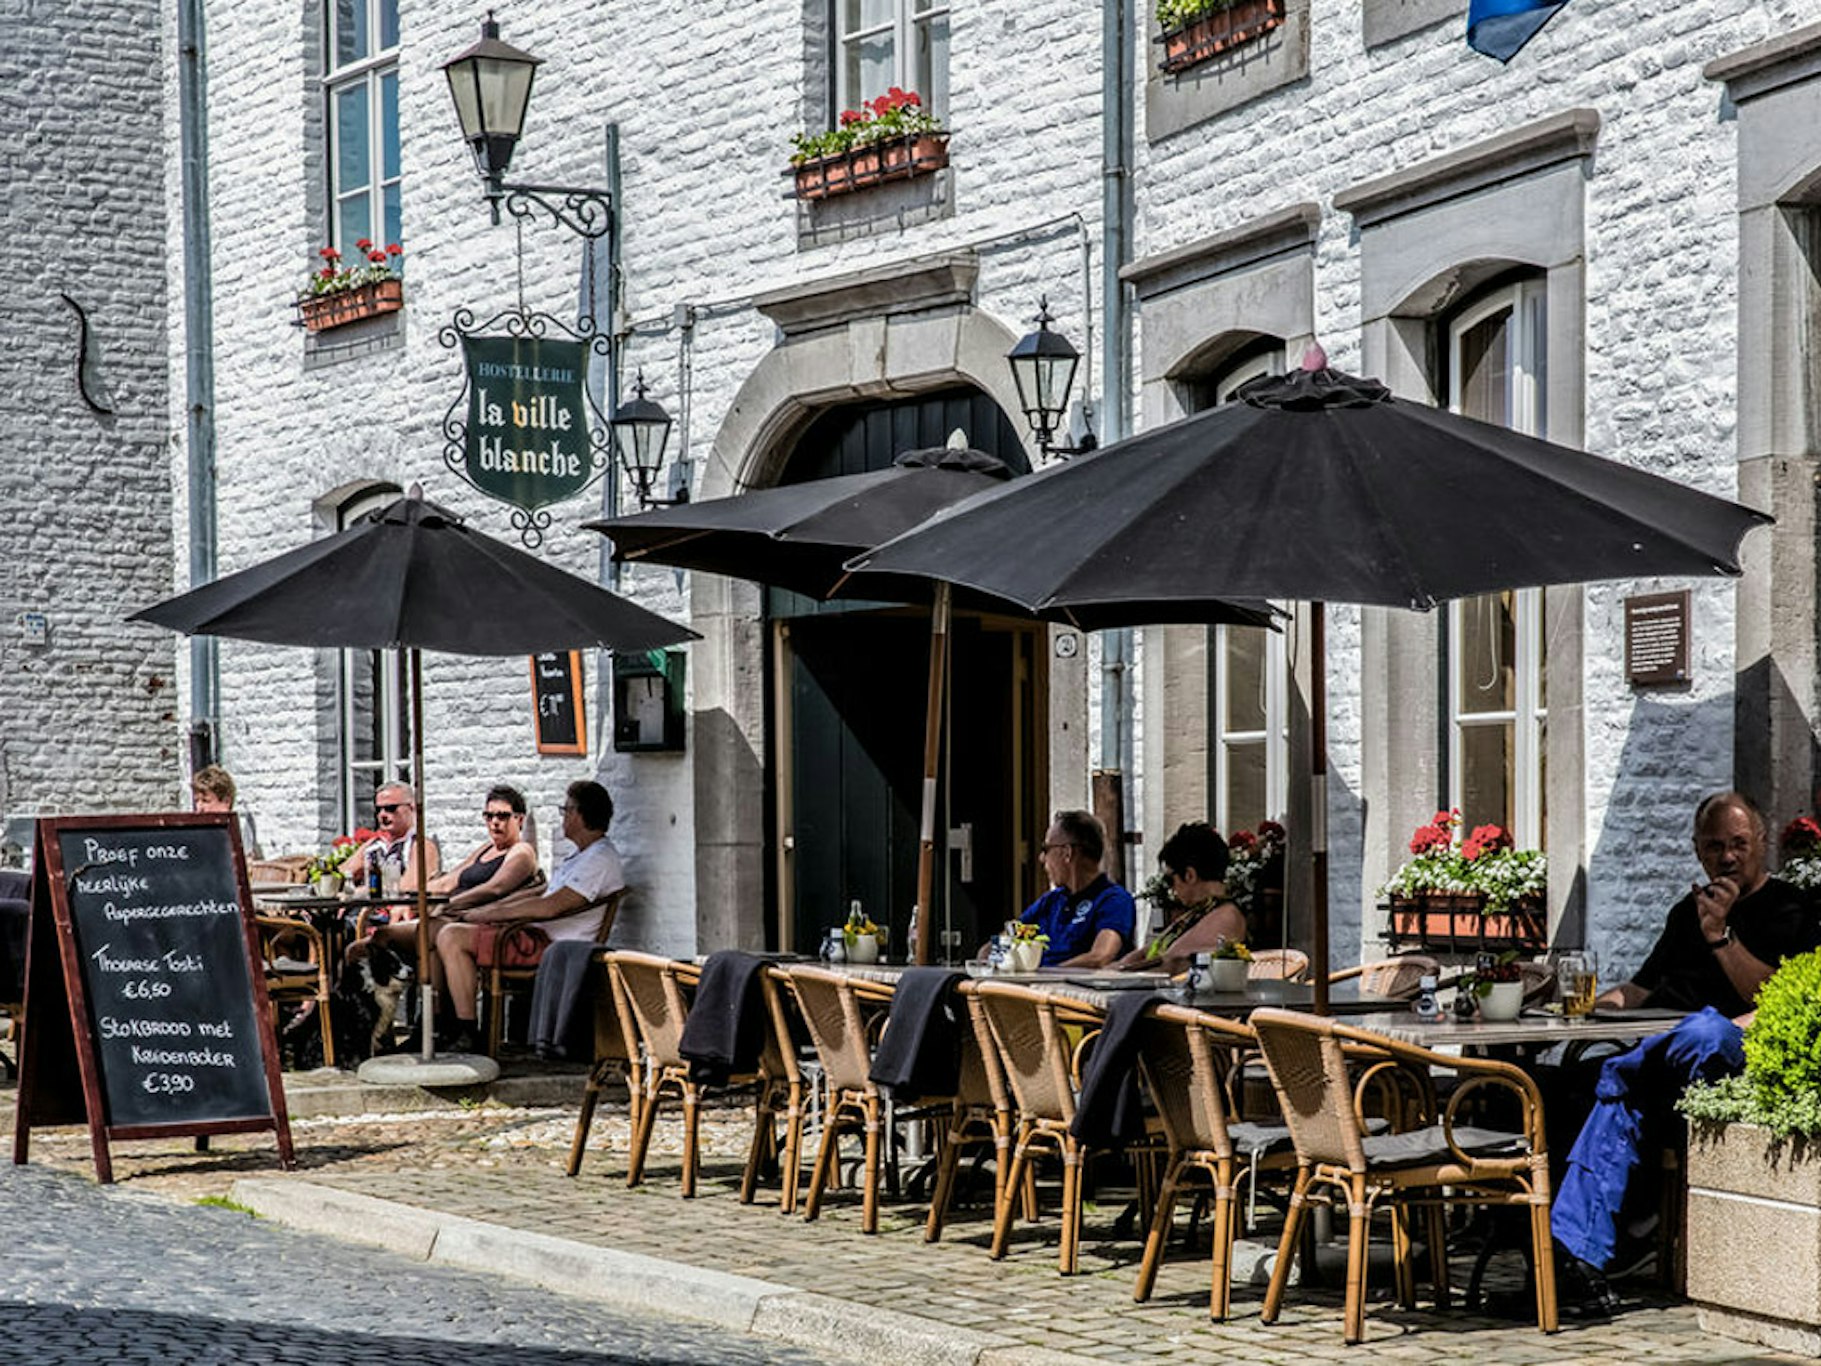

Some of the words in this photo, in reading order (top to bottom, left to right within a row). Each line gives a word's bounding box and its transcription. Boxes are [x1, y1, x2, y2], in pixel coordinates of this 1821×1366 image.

[479, 362, 575, 382] HOSTELLERIE
[478, 387, 506, 426] la
[511, 396, 572, 430] ville
[479, 435, 581, 477] blanche
[121, 979, 172, 1000] €6,50
[199, 1020, 233, 1038] met
[142, 1072, 195, 1095] €3,90
